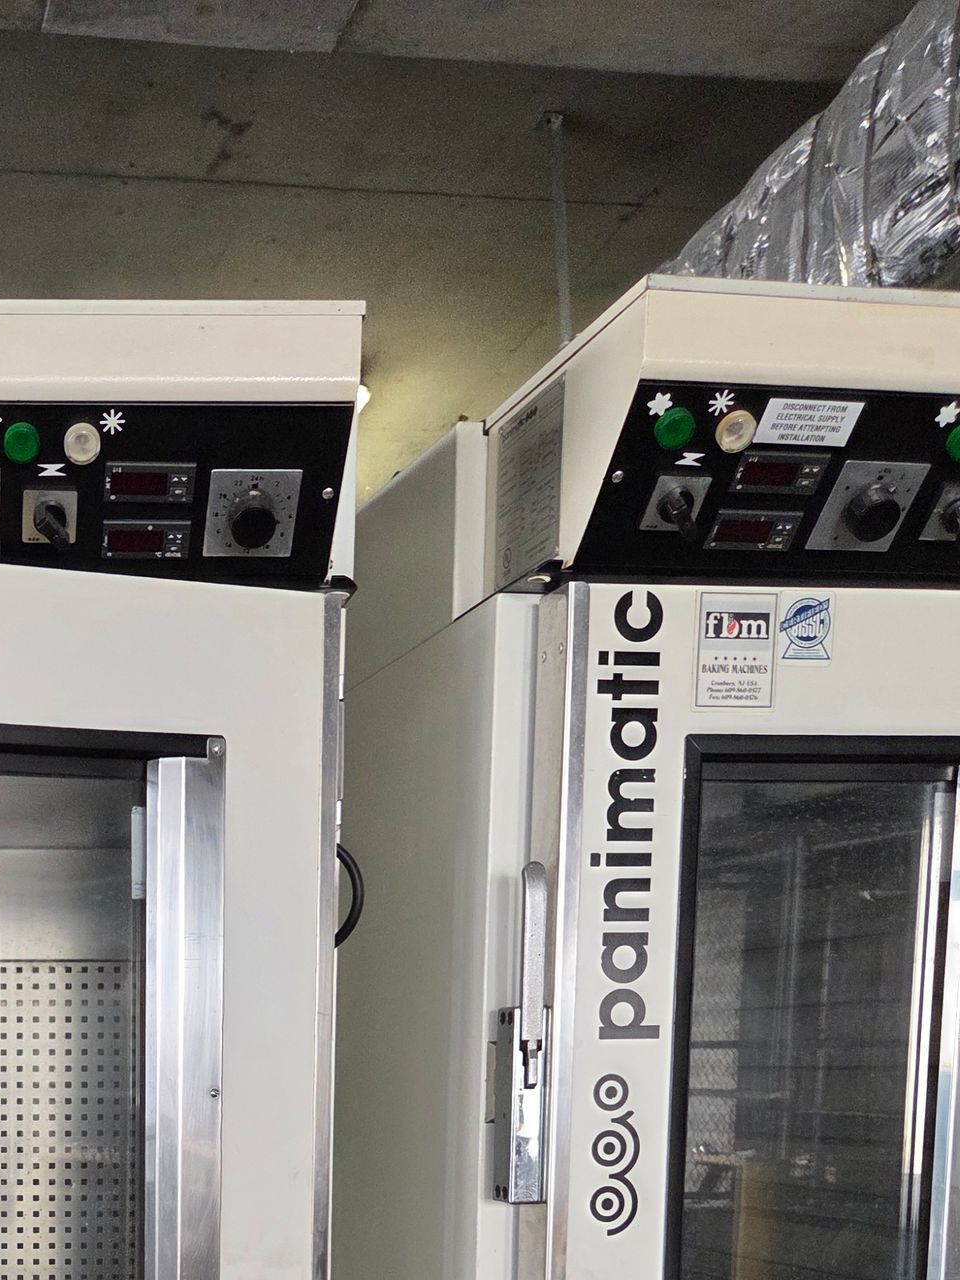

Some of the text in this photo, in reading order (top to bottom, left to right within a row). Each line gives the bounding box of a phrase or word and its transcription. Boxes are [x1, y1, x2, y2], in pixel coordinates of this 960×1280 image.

[783, 403, 848, 413] DISCONNECT FROM
[817, 415, 846, 423] SUPPLY
[771, 423, 841, 433] BEFORE ATTEMPTING
[777, 434, 826, 442] INSTALLATION
[706, 613, 769, 639] fbm
[702, 664, 768, 674] BAKING MACHINES
[590, 589, 664, 1040] panimatic
